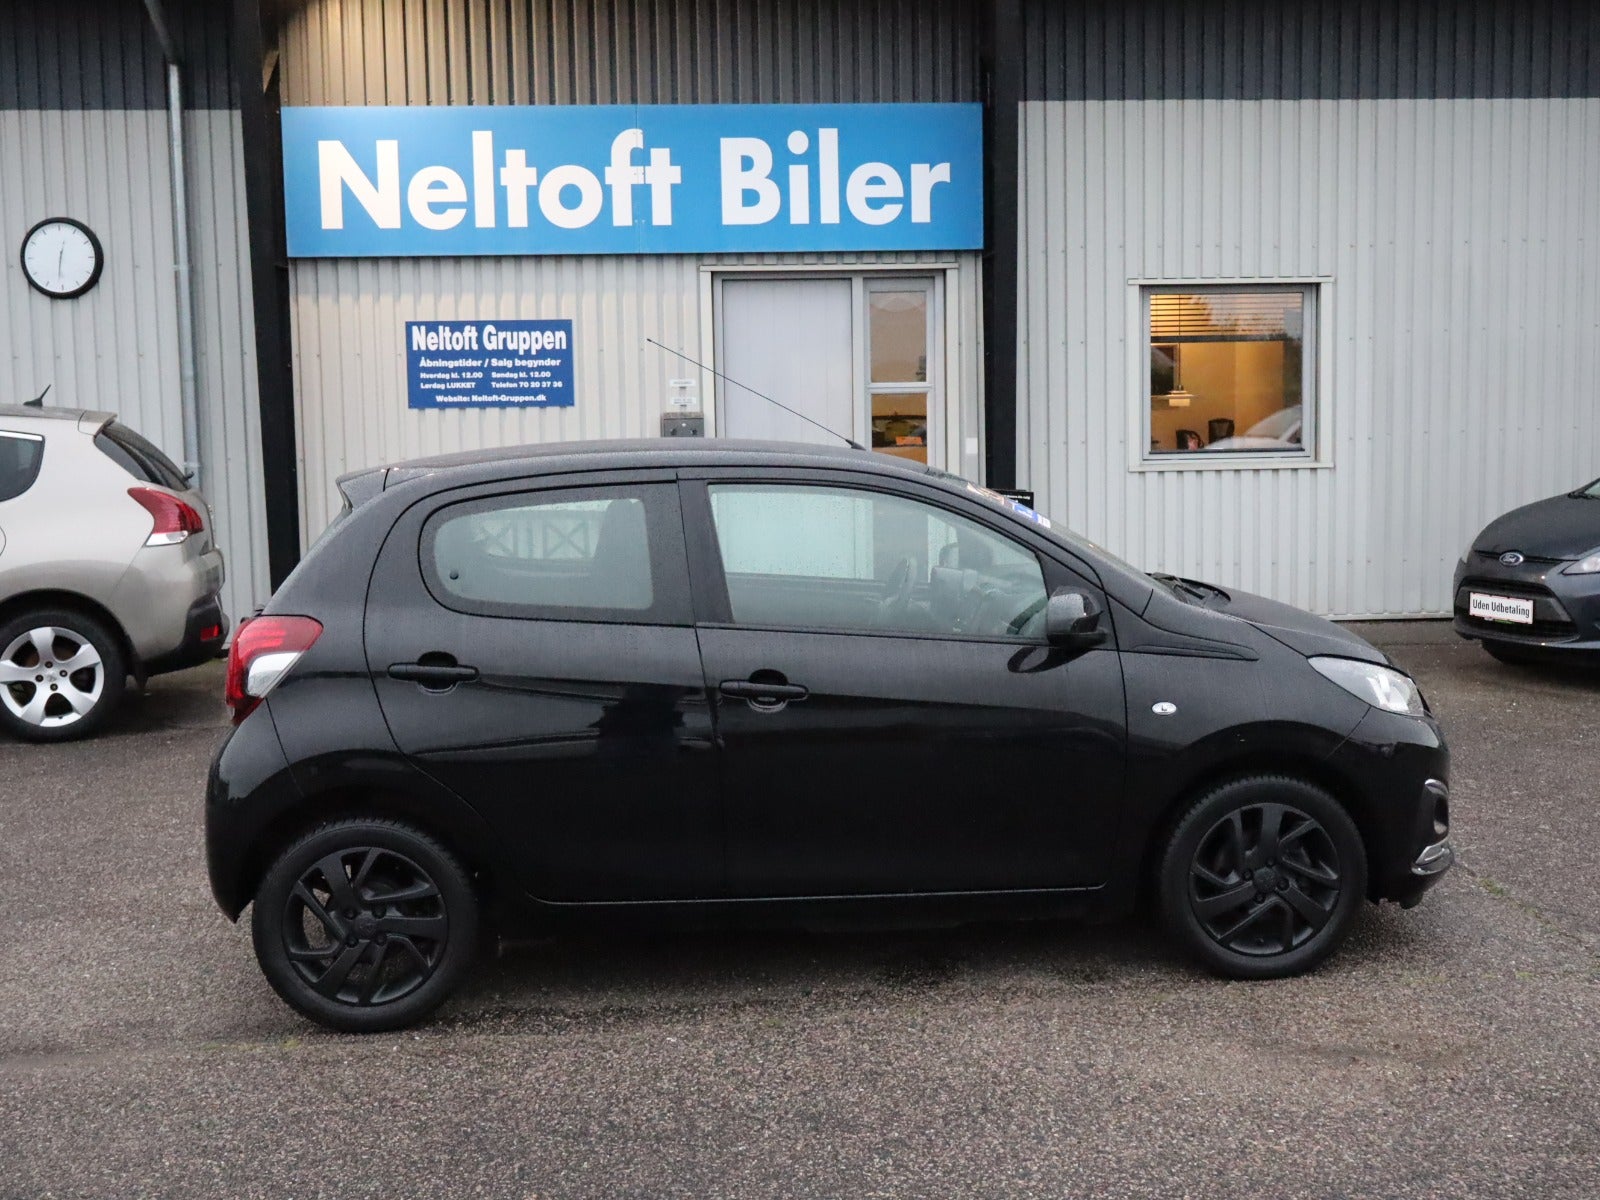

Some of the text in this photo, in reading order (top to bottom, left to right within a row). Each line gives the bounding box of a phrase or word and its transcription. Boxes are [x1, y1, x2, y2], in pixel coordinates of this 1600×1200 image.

[318, 127, 951, 231] Neltoft Biler
[412, 324, 567, 355] Neltoft Gruppen
[419, 356, 482, 369] Åbningstider
[491, 358, 513, 368] Salg
[514, 358, 561, 368] begynder
[462, 371, 483, 379] 12.00
[530, 370, 551, 378] 12.00
[446, 381, 476, 389] LUKKET
[491, 381, 518, 389] Telefon
[436, 393, 547, 403] Website: Neltoft-Gruppen.dk
[1472, 599, 1530, 618] Uden Udbetaling
